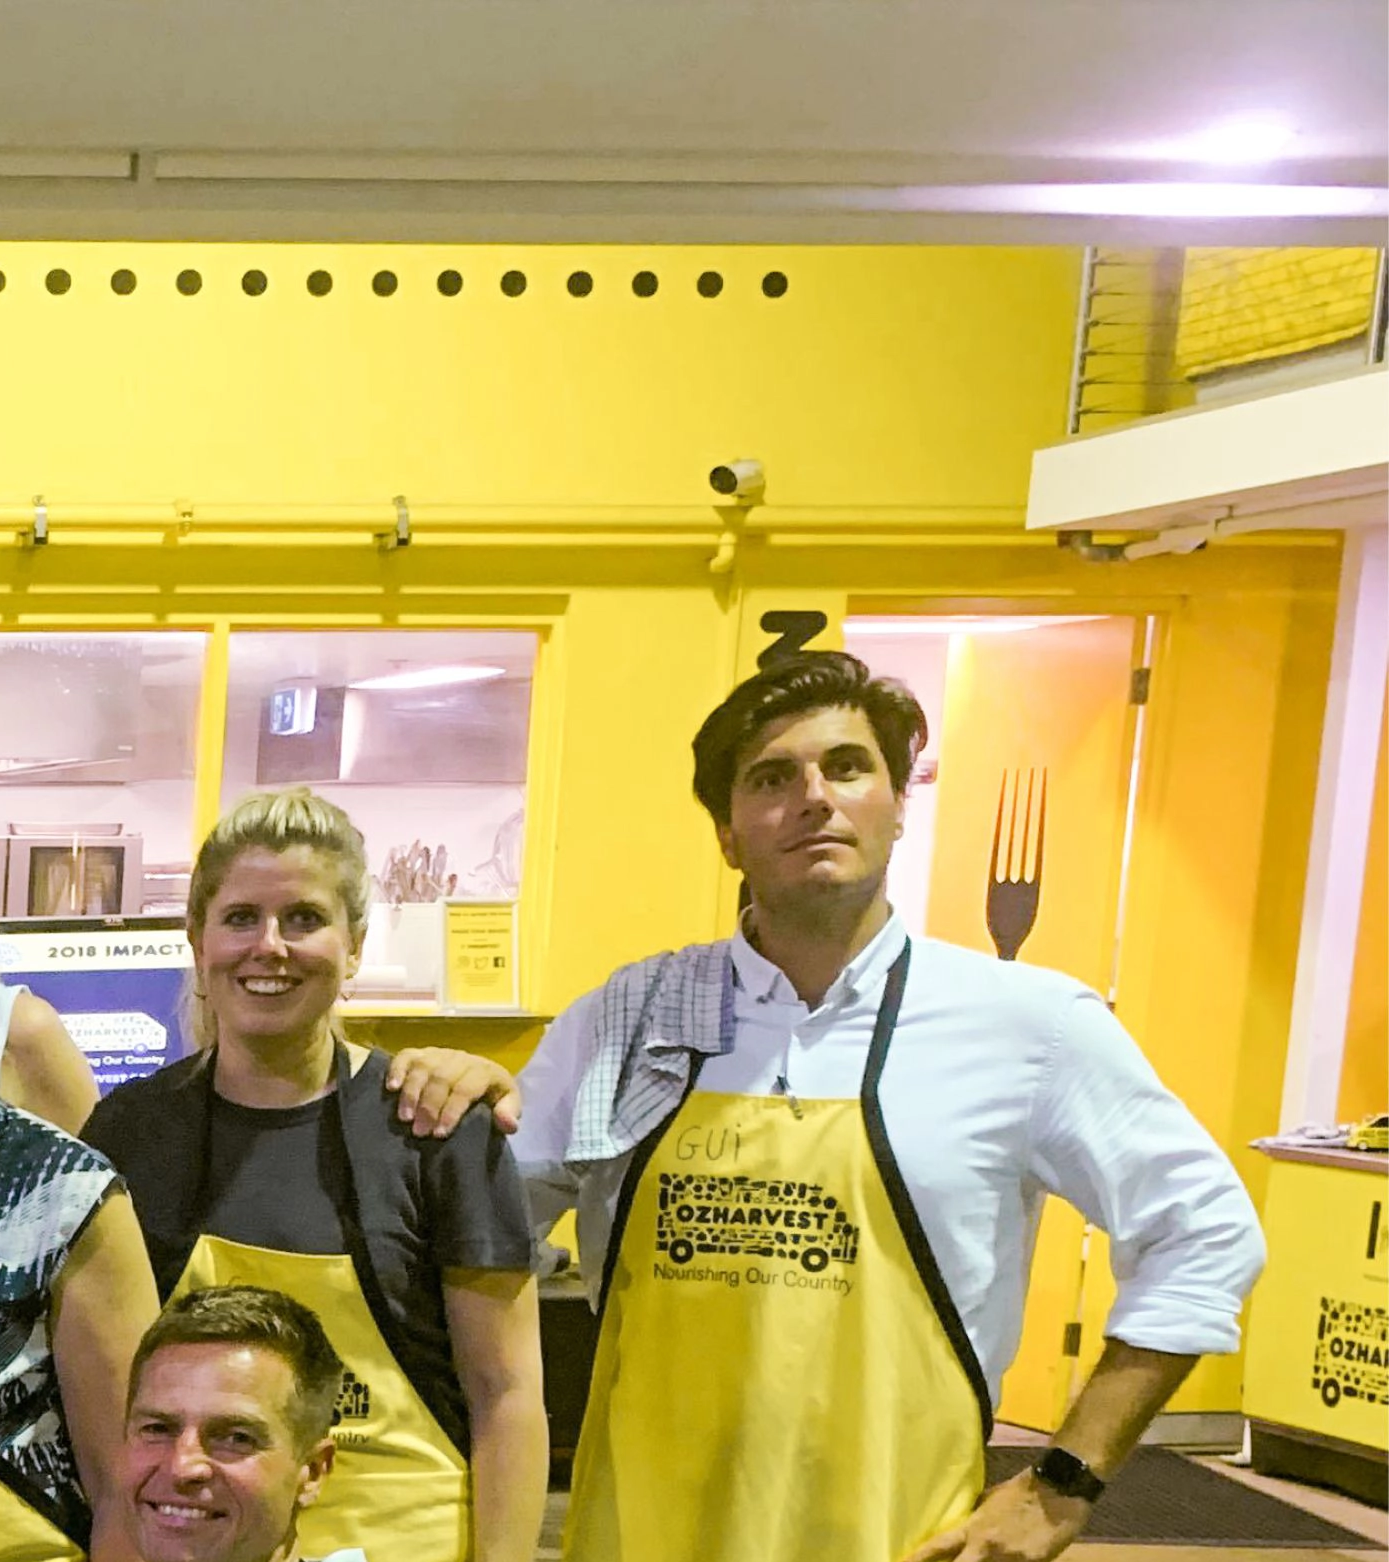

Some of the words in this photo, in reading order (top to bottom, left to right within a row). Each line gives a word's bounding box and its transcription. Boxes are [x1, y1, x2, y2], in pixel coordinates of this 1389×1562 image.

[47, 945, 97, 959] 2018
[105, 943, 187, 957] IMPACT
[124, 1055, 166, 1066] Country
[676, 1204, 829, 1230] OZHARVEST
[653, 1262, 740, 1288] Nourishing
[745, 1266, 779, 1286] Our
[783, 1269, 853, 1297] Country
